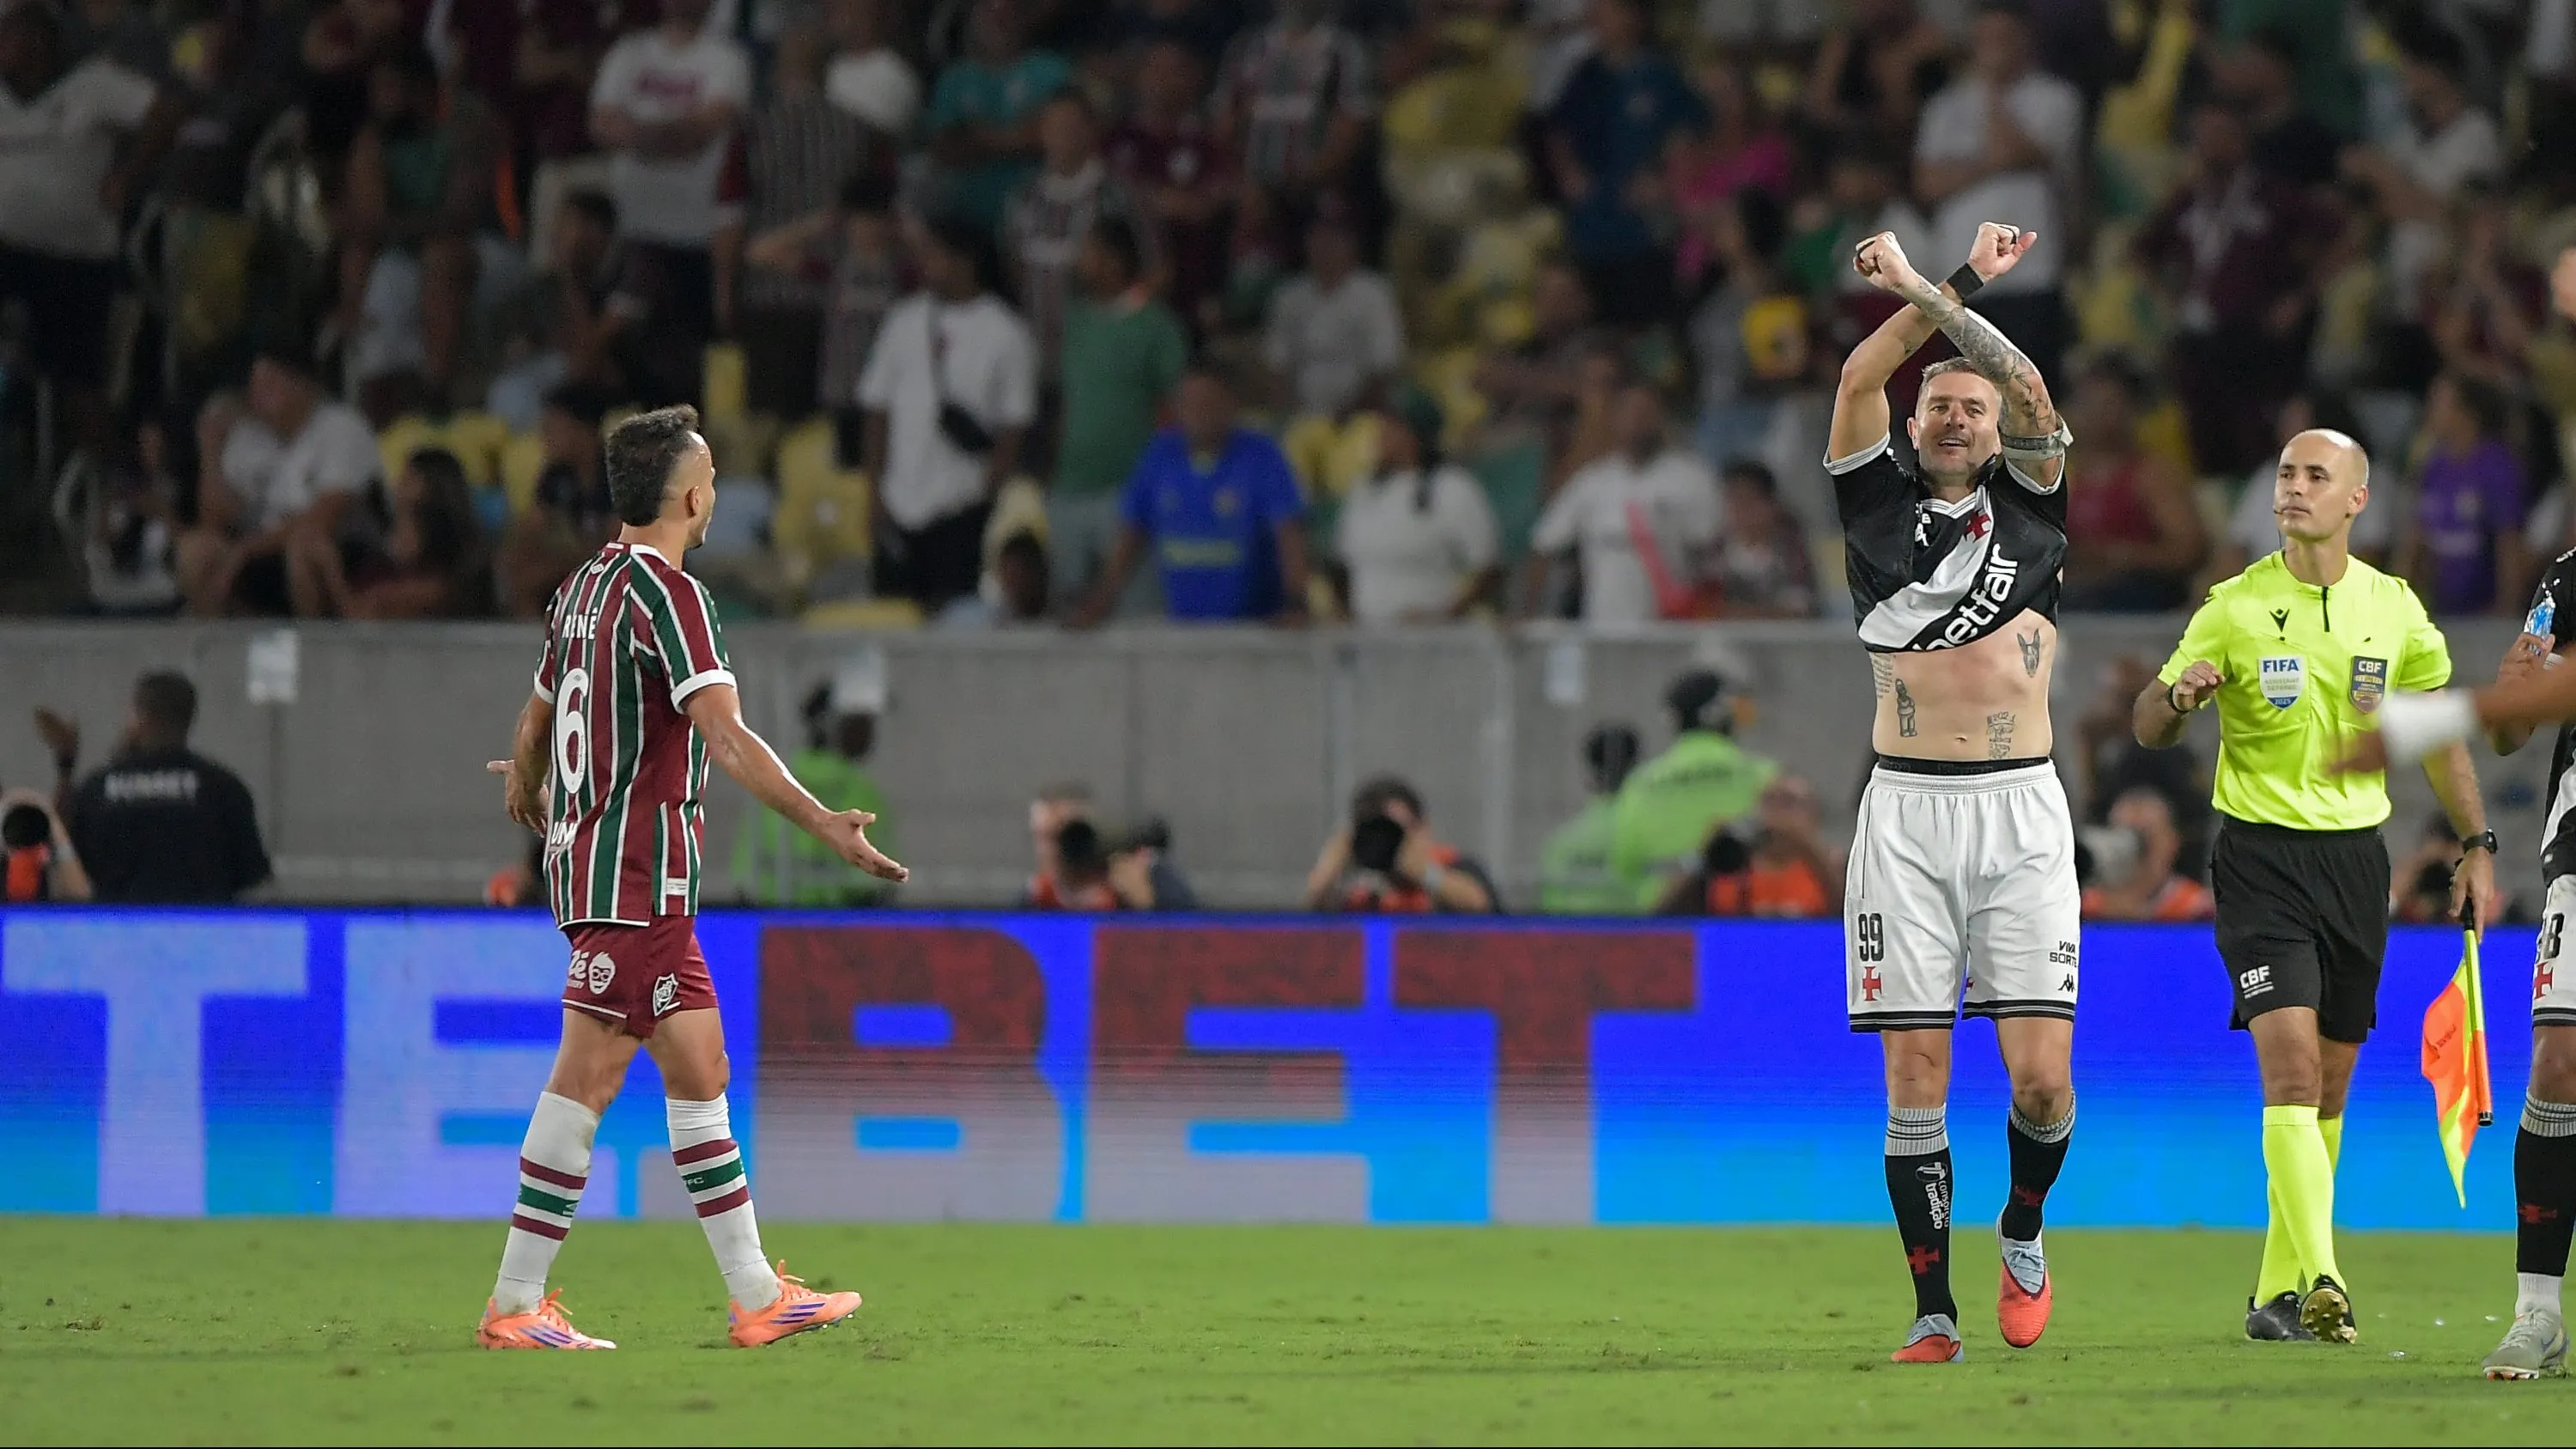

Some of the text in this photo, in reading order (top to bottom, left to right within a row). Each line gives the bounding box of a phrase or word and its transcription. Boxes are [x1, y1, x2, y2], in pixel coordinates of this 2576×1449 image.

[562, 606, 598, 639] RENÉ
[2263, 659, 2299, 673] FIFA
[2358, 660, 2382, 673] CBF
[556, 667, 589, 795] 6
[1858, 913, 1885, 962] 99
[2059, 940, 2075, 953] VIVA
[2539, 912, 2565, 960] 8
[2240, 965, 2270, 989] CBF
[1925, 1182, 1945, 1230] tradição
